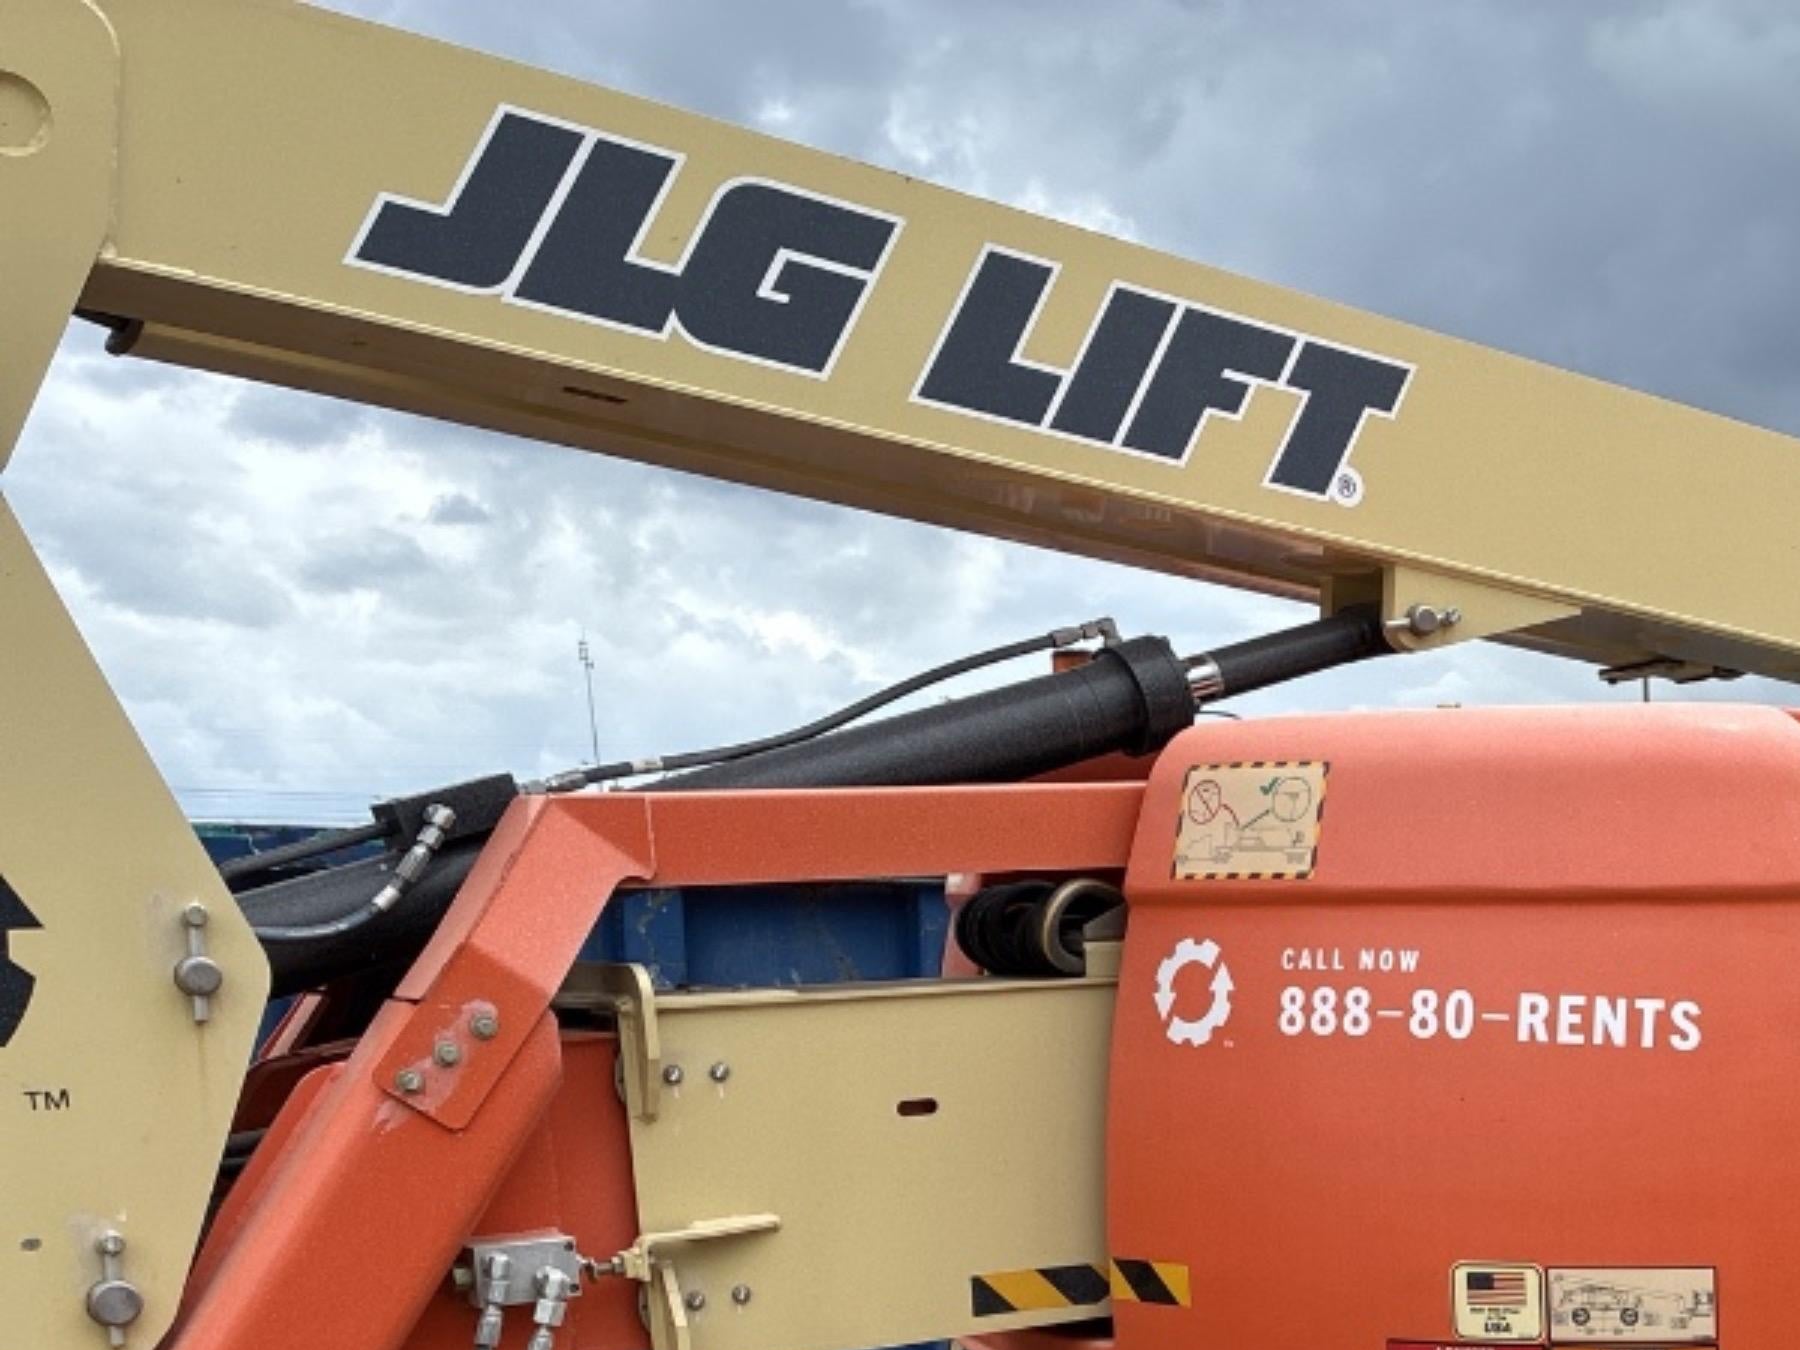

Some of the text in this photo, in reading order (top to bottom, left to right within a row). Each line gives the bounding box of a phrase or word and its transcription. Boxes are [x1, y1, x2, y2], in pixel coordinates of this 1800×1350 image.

[345, 103, 906, 381] JLG
[1280, 947, 1421, 973] CALL NOW
[1279, 985, 1703, 1052] 888-80-RENTS
